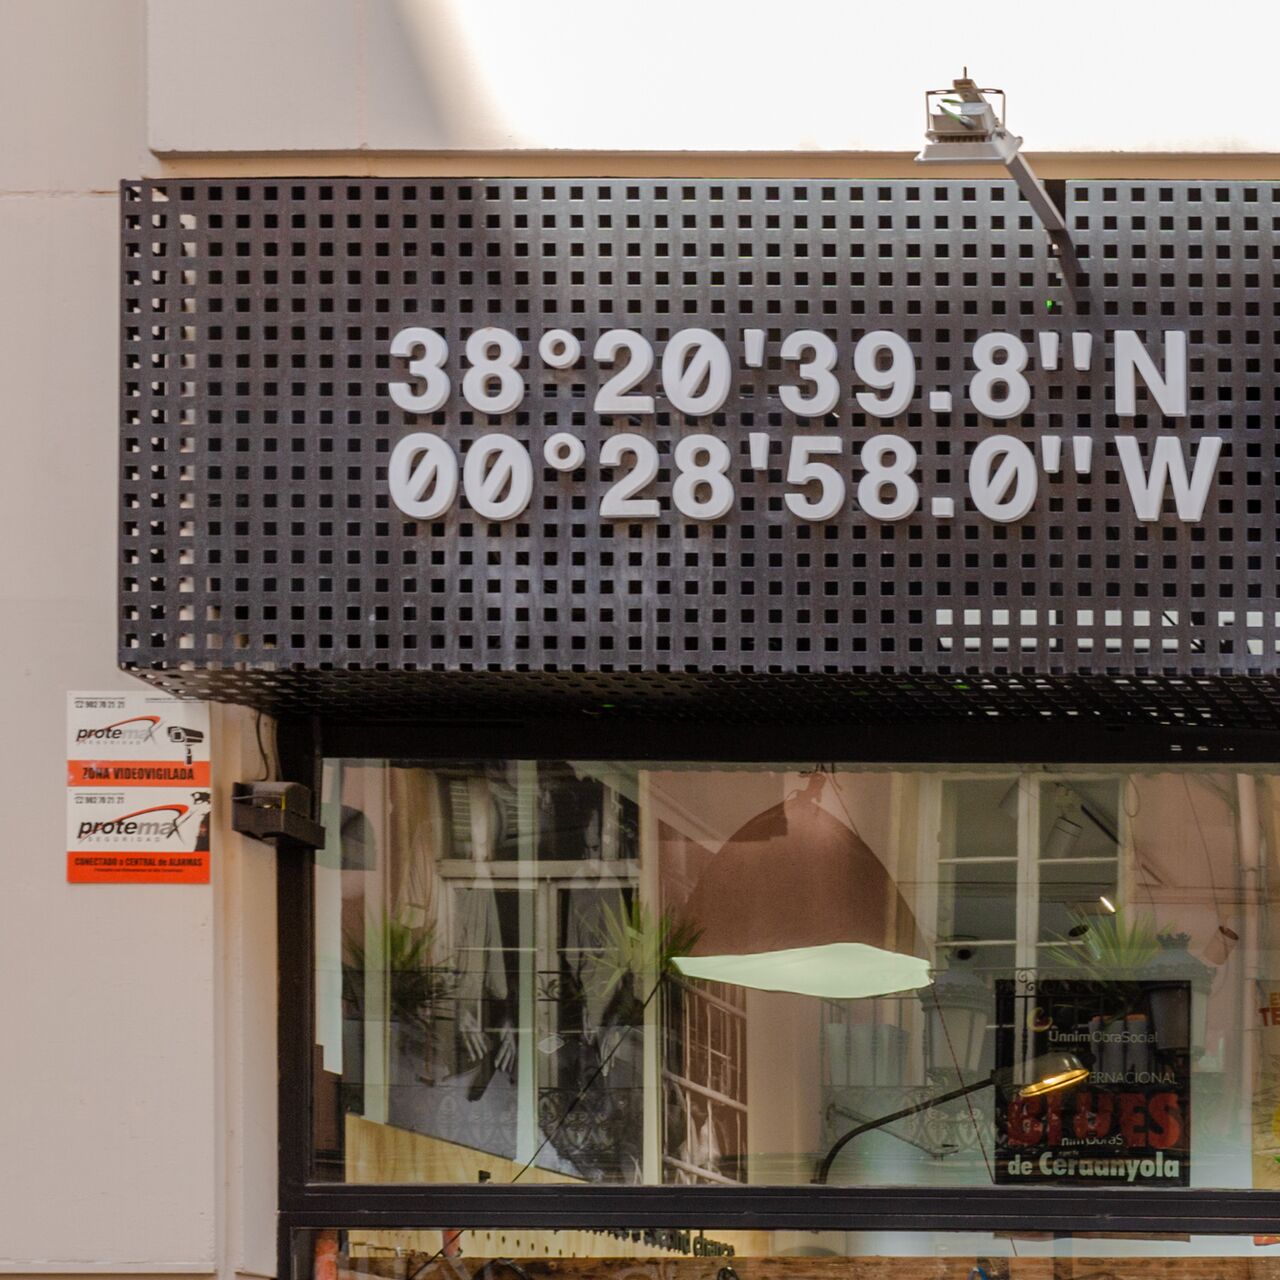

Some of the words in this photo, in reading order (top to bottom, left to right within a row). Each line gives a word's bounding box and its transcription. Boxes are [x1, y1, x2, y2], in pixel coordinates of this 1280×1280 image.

[76, 721, 163, 743] protemax
[82, 768, 109, 780] ZONA
[113, 767, 194, 780] VIDEOVIGILADA
[77, 814, 192, 843] protemax
[1086, 1071, 1178, 1084] ERNACIONAL
[1008, 1154, 1032, 1175] de
